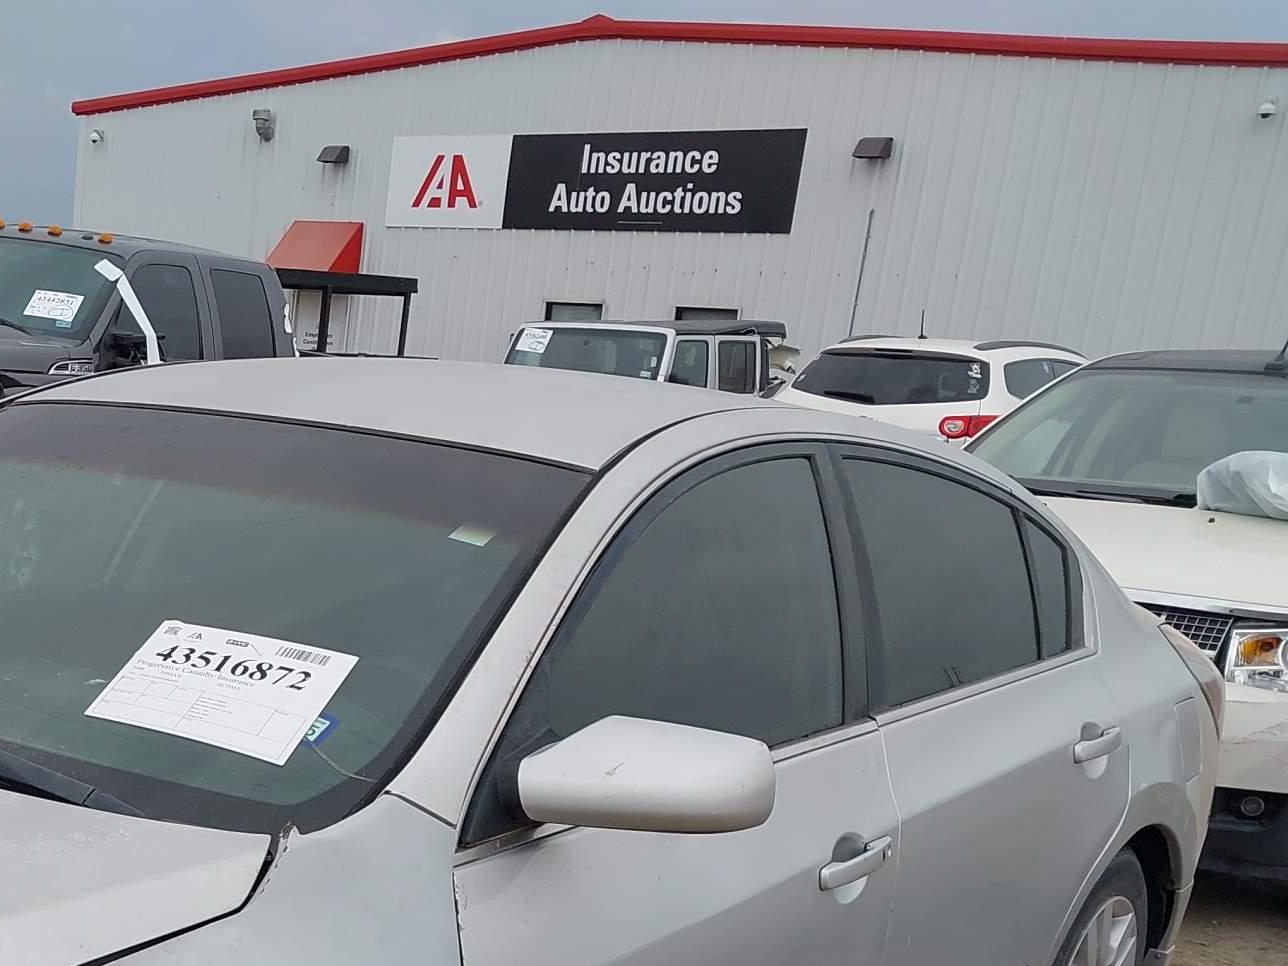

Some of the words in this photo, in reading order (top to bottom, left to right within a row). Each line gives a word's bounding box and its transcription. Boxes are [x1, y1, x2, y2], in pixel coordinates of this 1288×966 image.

[581, 143, 719, 175] Insurance
[548, 183, 611, 214] Auto
[617, 183, 743, 215] Auctions
[155, 644, 312, 691] 43516872
[218, 674, 256, 688] Insurance
